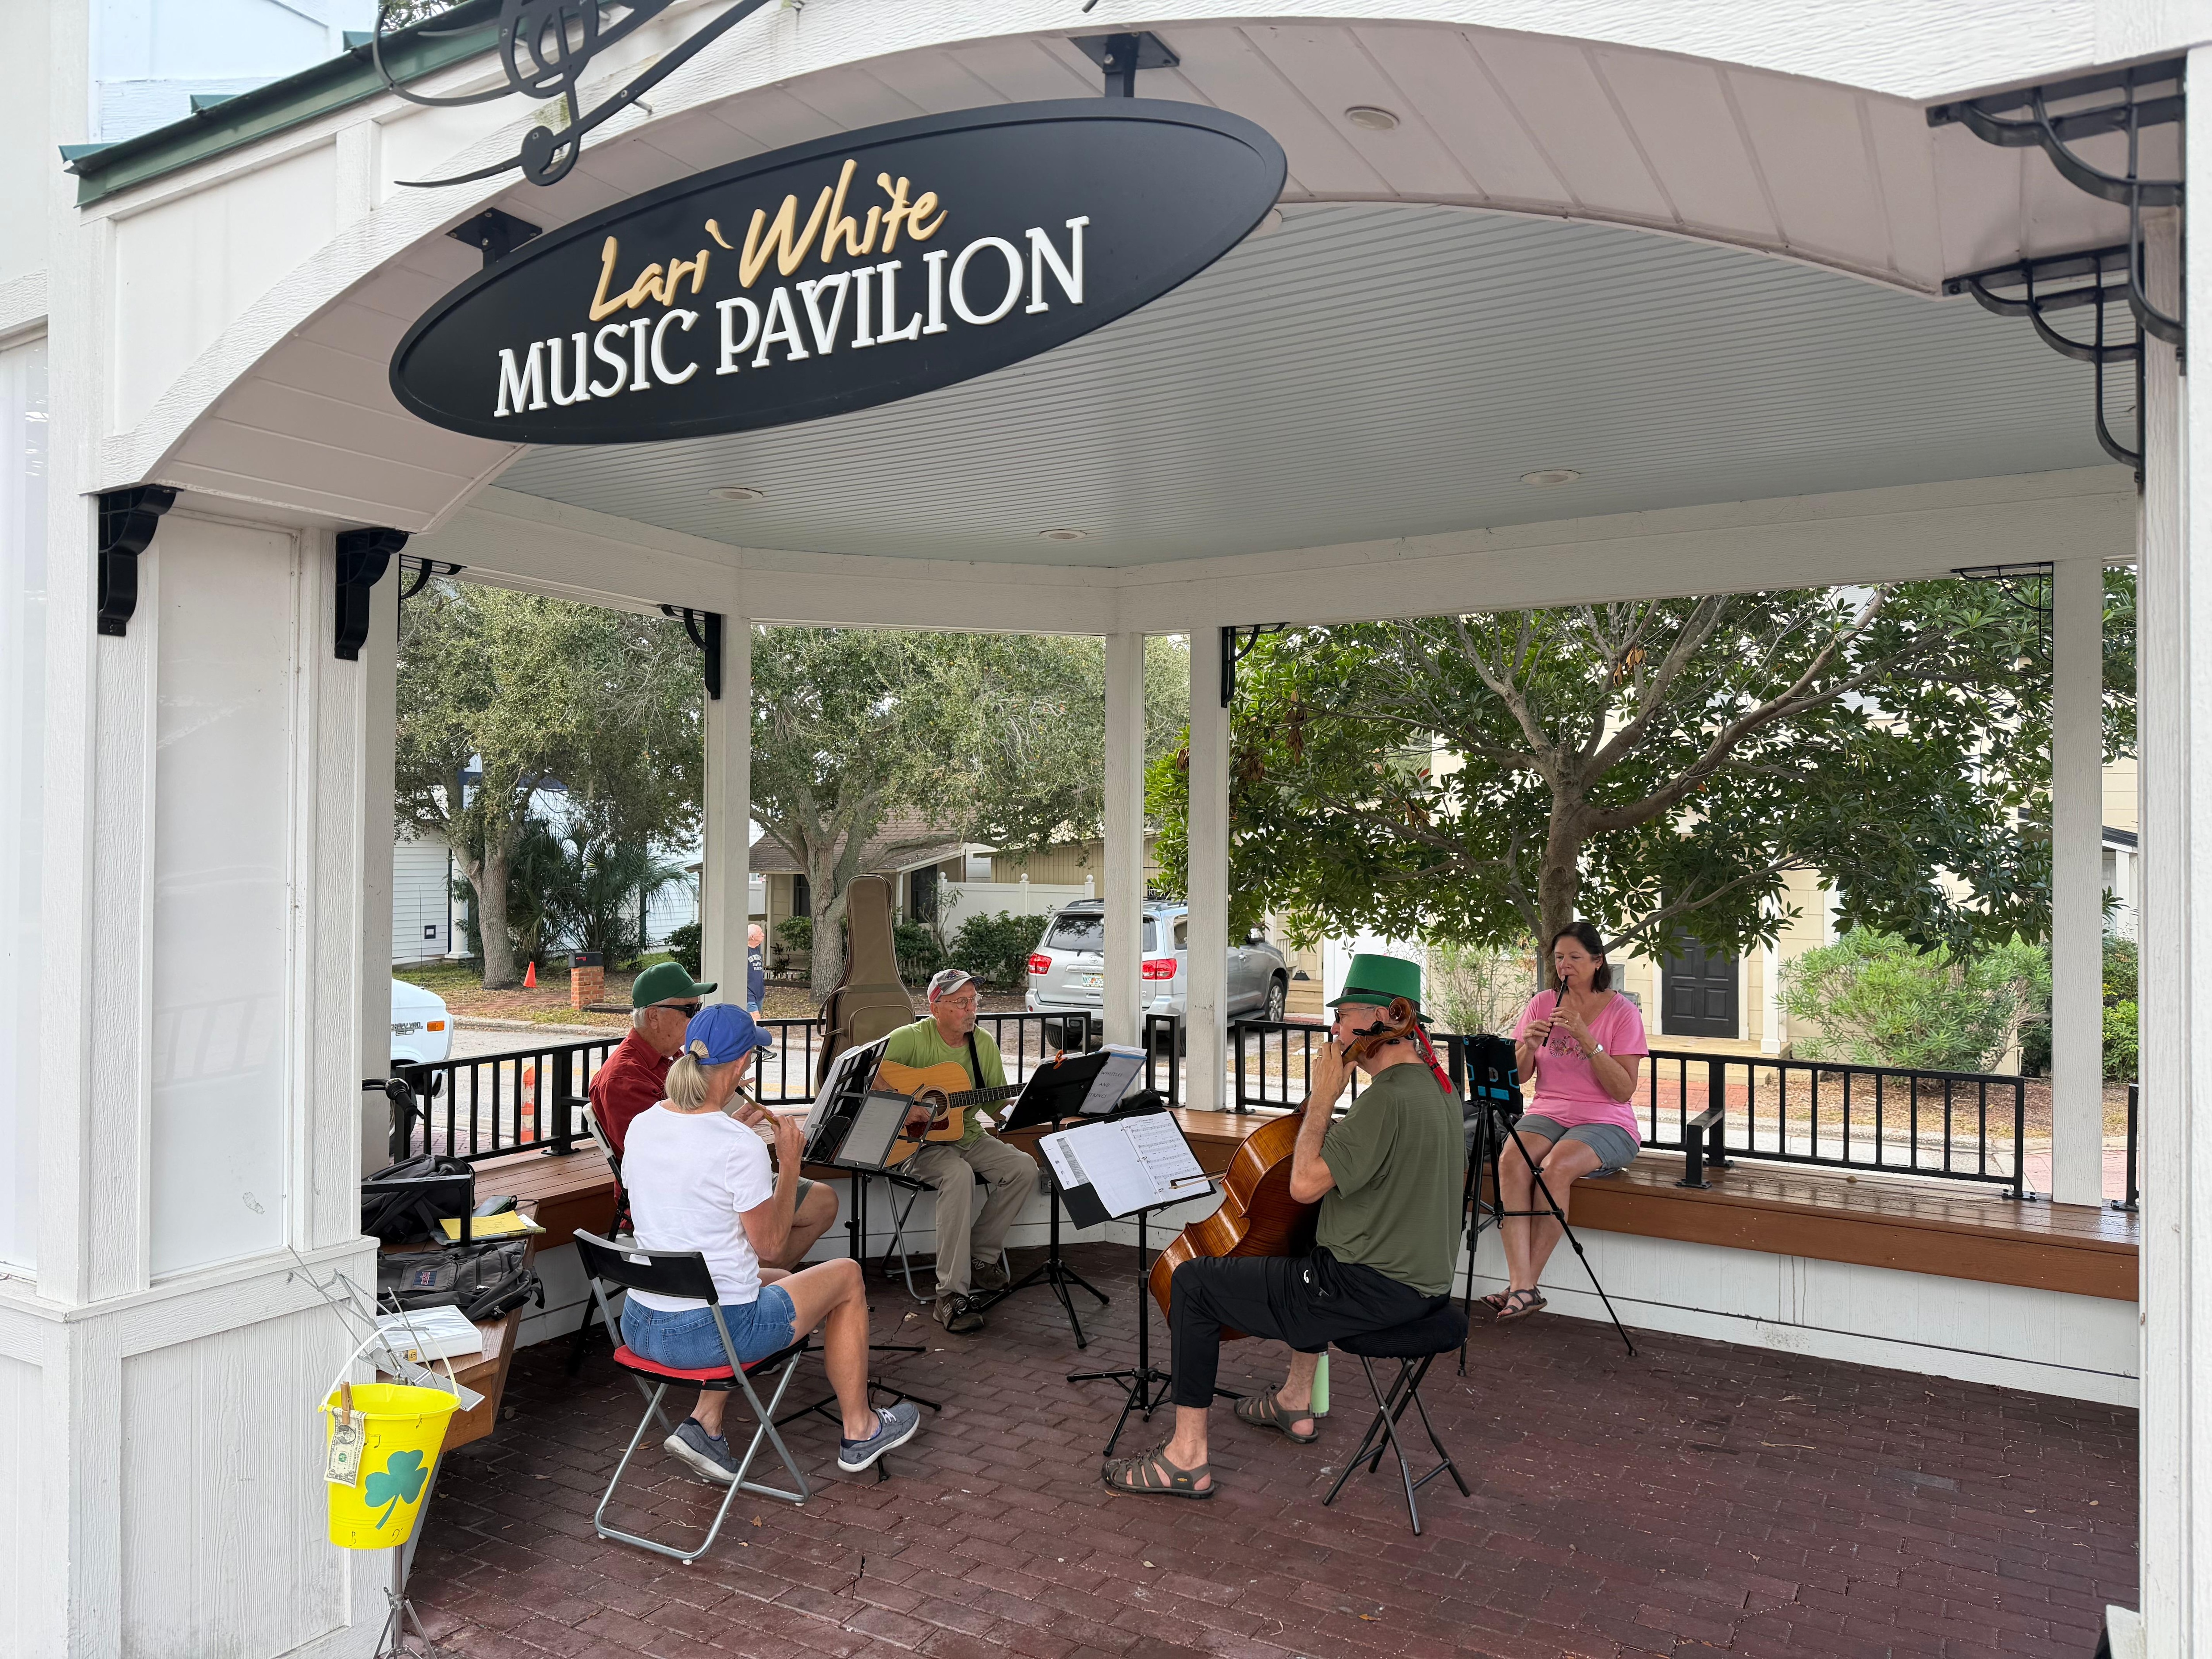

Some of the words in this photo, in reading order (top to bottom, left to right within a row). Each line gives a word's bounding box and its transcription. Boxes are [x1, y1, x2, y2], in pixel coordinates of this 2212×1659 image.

[738, 159, 949, 288] White
[493, 308, 700, 418] MUSIC
[715, 215, 1090, 376] PAVILION
[972, 1258, 985, 1270] N
